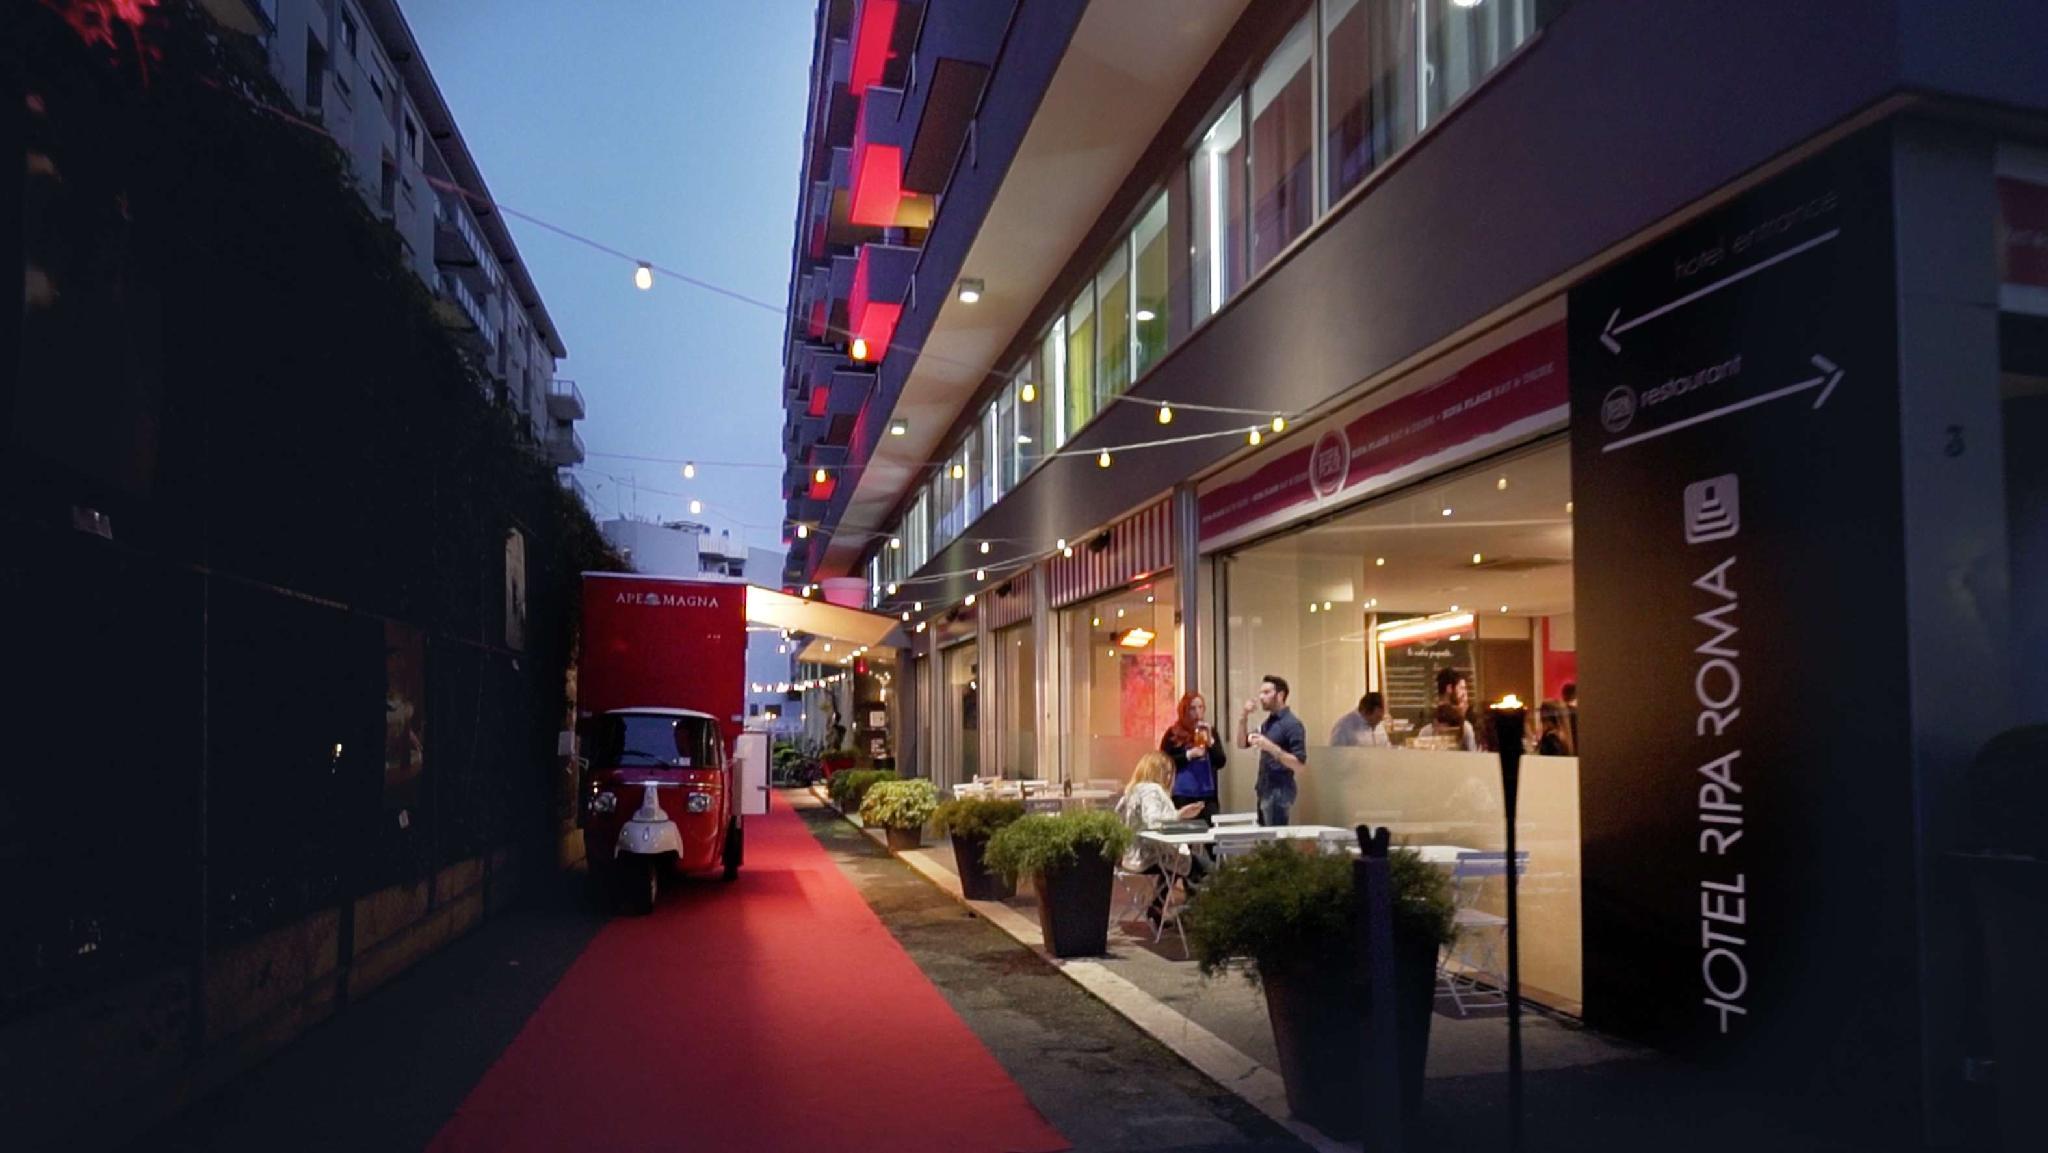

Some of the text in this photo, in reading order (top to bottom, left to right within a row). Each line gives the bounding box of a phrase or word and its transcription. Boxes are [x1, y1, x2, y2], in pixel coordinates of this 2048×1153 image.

[1674, 234, 1725, 283] hotel
[1640, 353, 1742, 409] restaurant
[615, 592, 719, 608] APE MAGNA
[1692, 556, 1748, 1034] HOTEL RIPA ROMA
